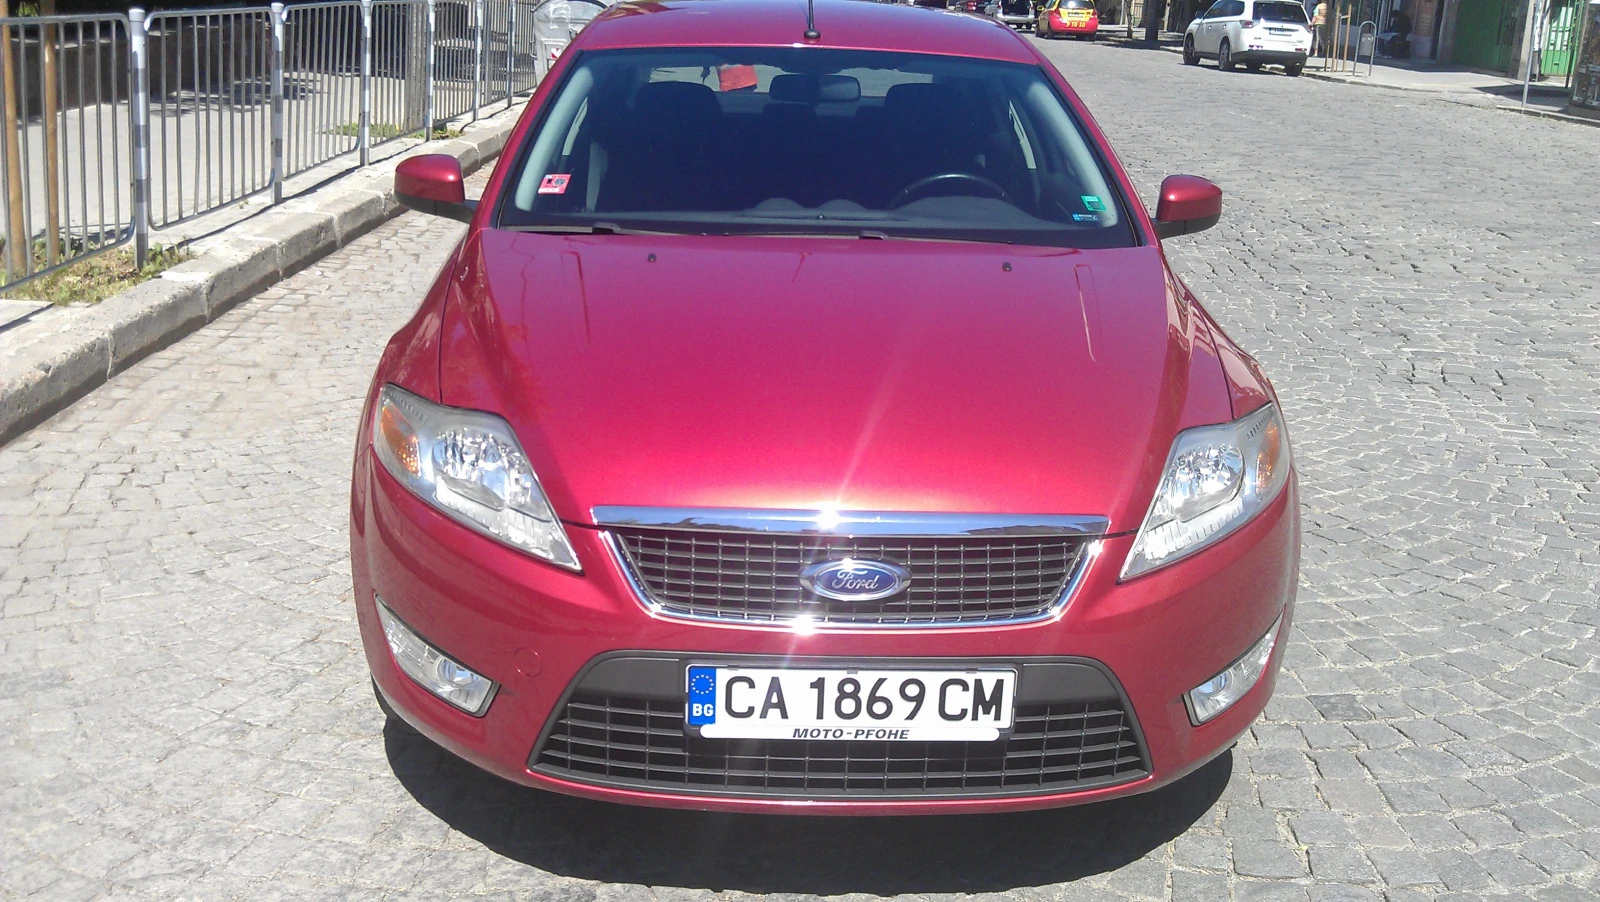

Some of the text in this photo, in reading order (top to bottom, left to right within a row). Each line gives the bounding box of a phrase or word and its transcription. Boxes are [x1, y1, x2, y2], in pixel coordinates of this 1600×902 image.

[832, 570, 880, 589] Ford
[725, 676, 1005, 722] CA 1869 CM
[692, 703, 714, 717] BG
[792, 728, 910, 740] MOTO-PFOHE
